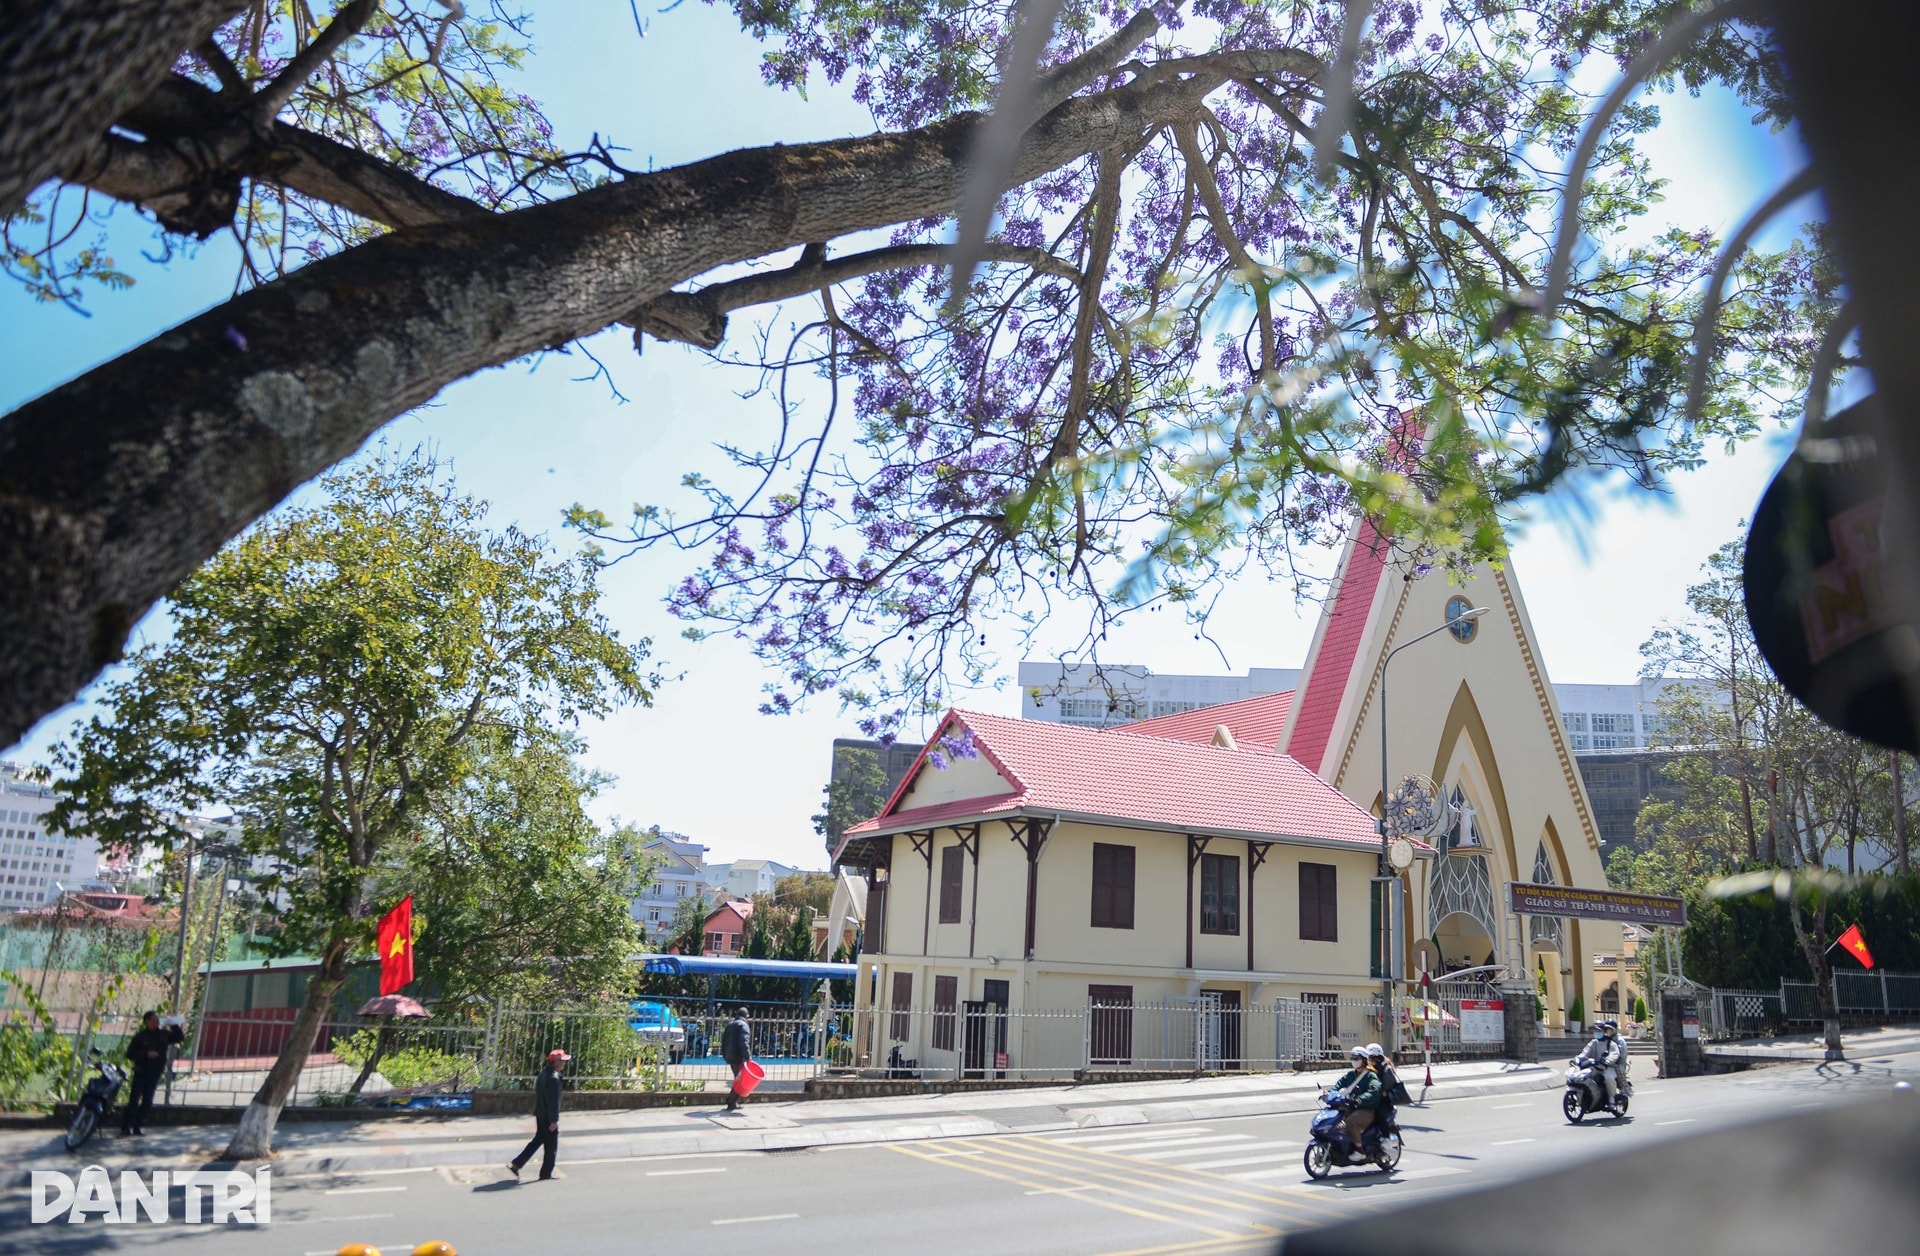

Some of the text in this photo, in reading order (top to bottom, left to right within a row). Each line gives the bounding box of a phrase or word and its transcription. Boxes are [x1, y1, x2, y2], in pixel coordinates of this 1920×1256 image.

[1525, 896, 1550, 907] GIÁO
[1570, 900, 1606, 912] THÁNH
[1609, 903, 1630, 914] TÂM
